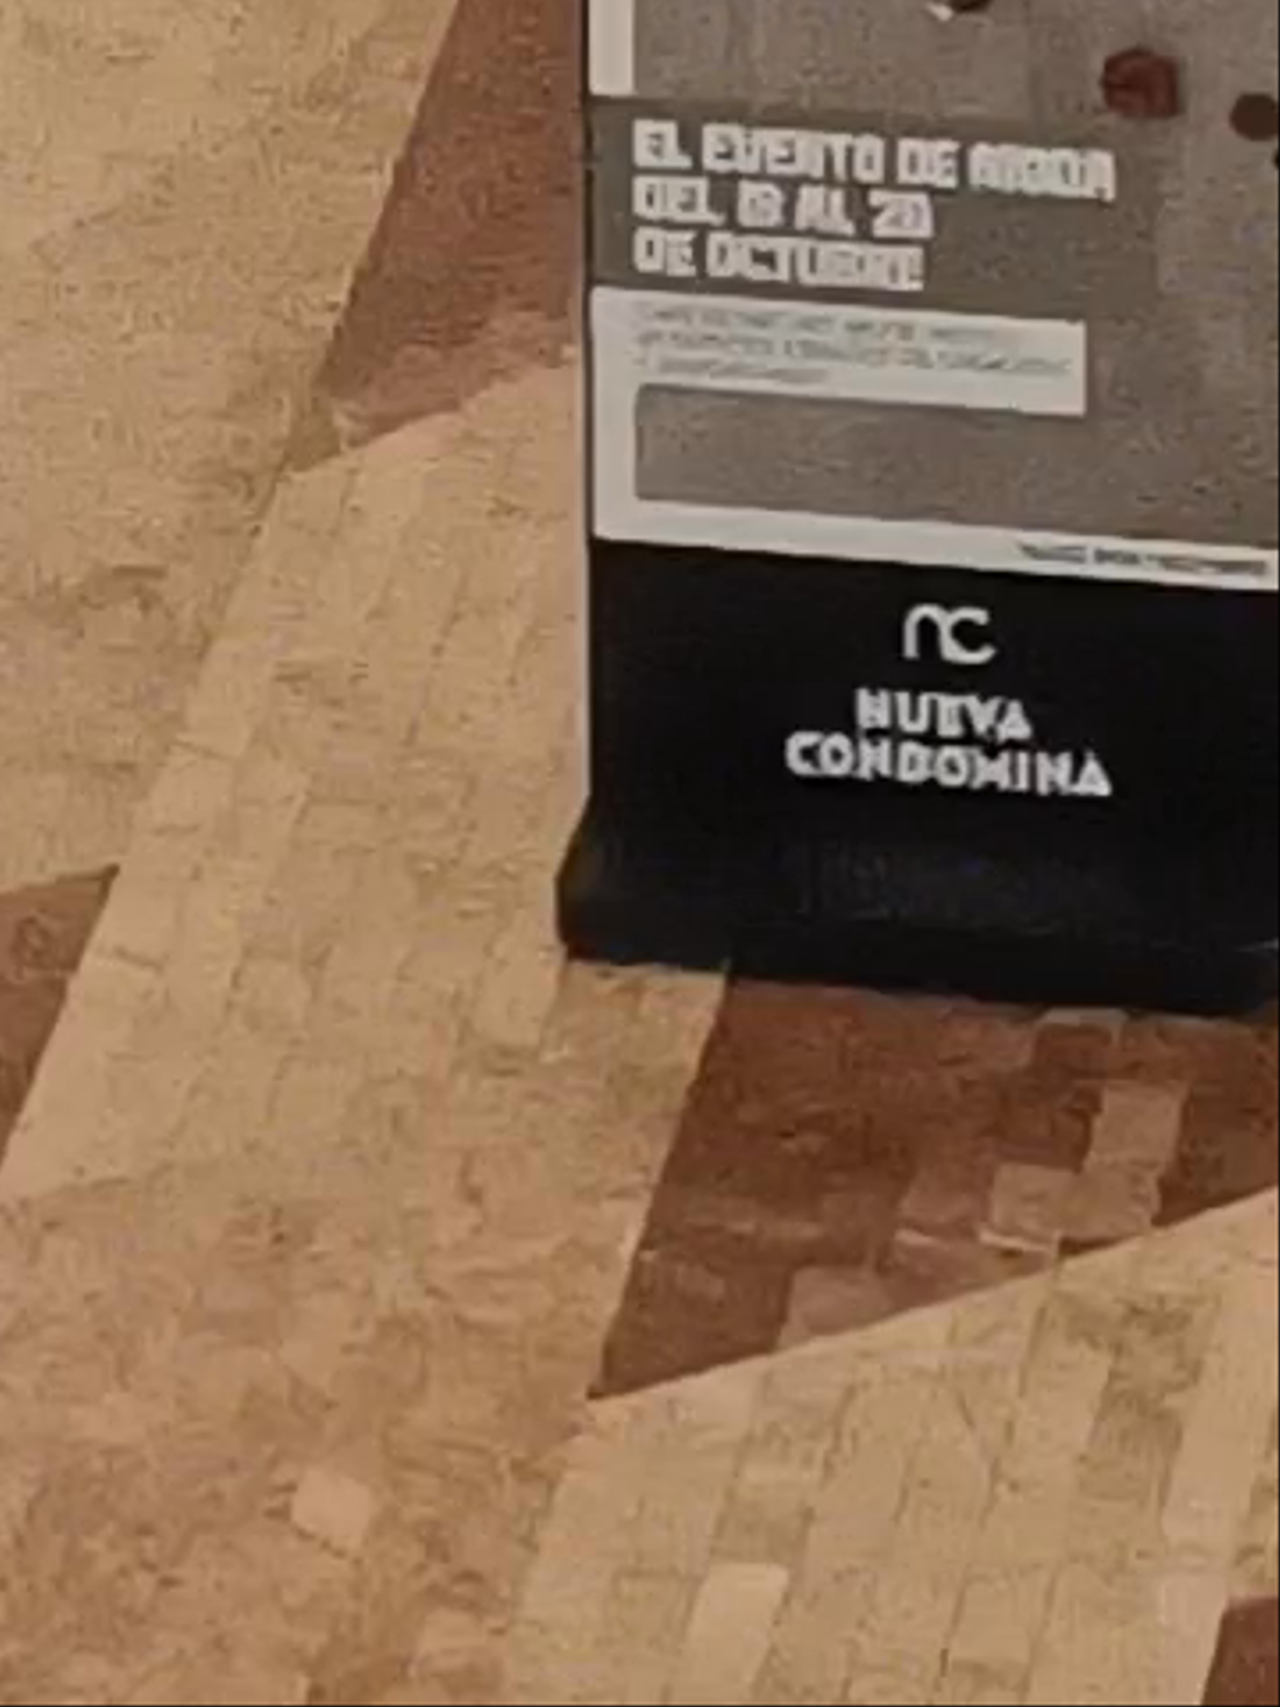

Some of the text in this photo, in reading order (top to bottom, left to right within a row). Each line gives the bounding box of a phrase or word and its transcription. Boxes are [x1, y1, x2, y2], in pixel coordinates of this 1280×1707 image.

[633, 119, 693, 170] EL
[702, 123, 885, 184] EVENTO
[896, 137, 960, 188] DE
[633, 175, 726, 227] DEL
[633, 225, 697, 277] DE
[855, 687, 1033, 742] NUEVA
[784, 730, 1113, 797] CONDOMINA
